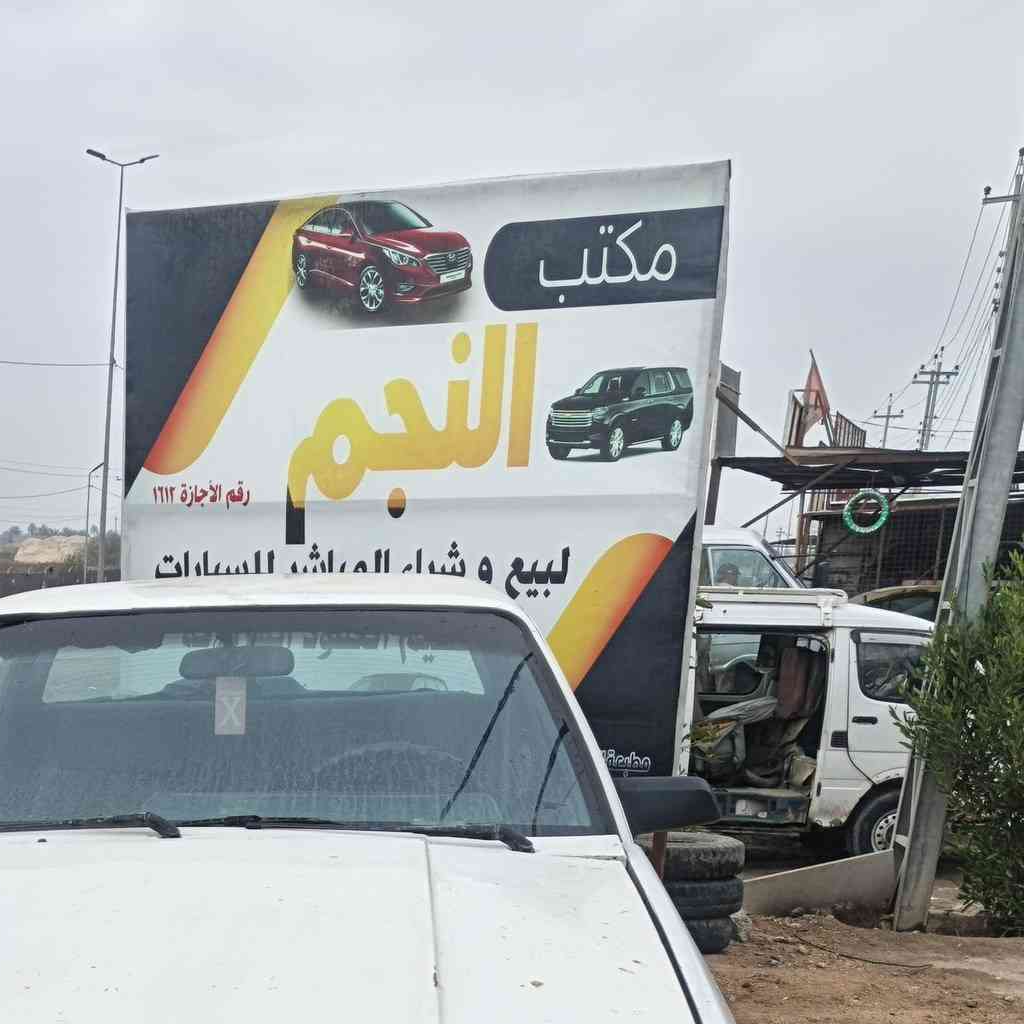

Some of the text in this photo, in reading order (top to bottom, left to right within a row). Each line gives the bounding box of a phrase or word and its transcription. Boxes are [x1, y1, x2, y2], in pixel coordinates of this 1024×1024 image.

[538, 221, 678, 304] مكتب
[286, 322, 539, 545] النجم
[225, 480, 250, 510] رقم
[477, 555, 494, 585] و
[505, 546, 570, 600] لبيع
